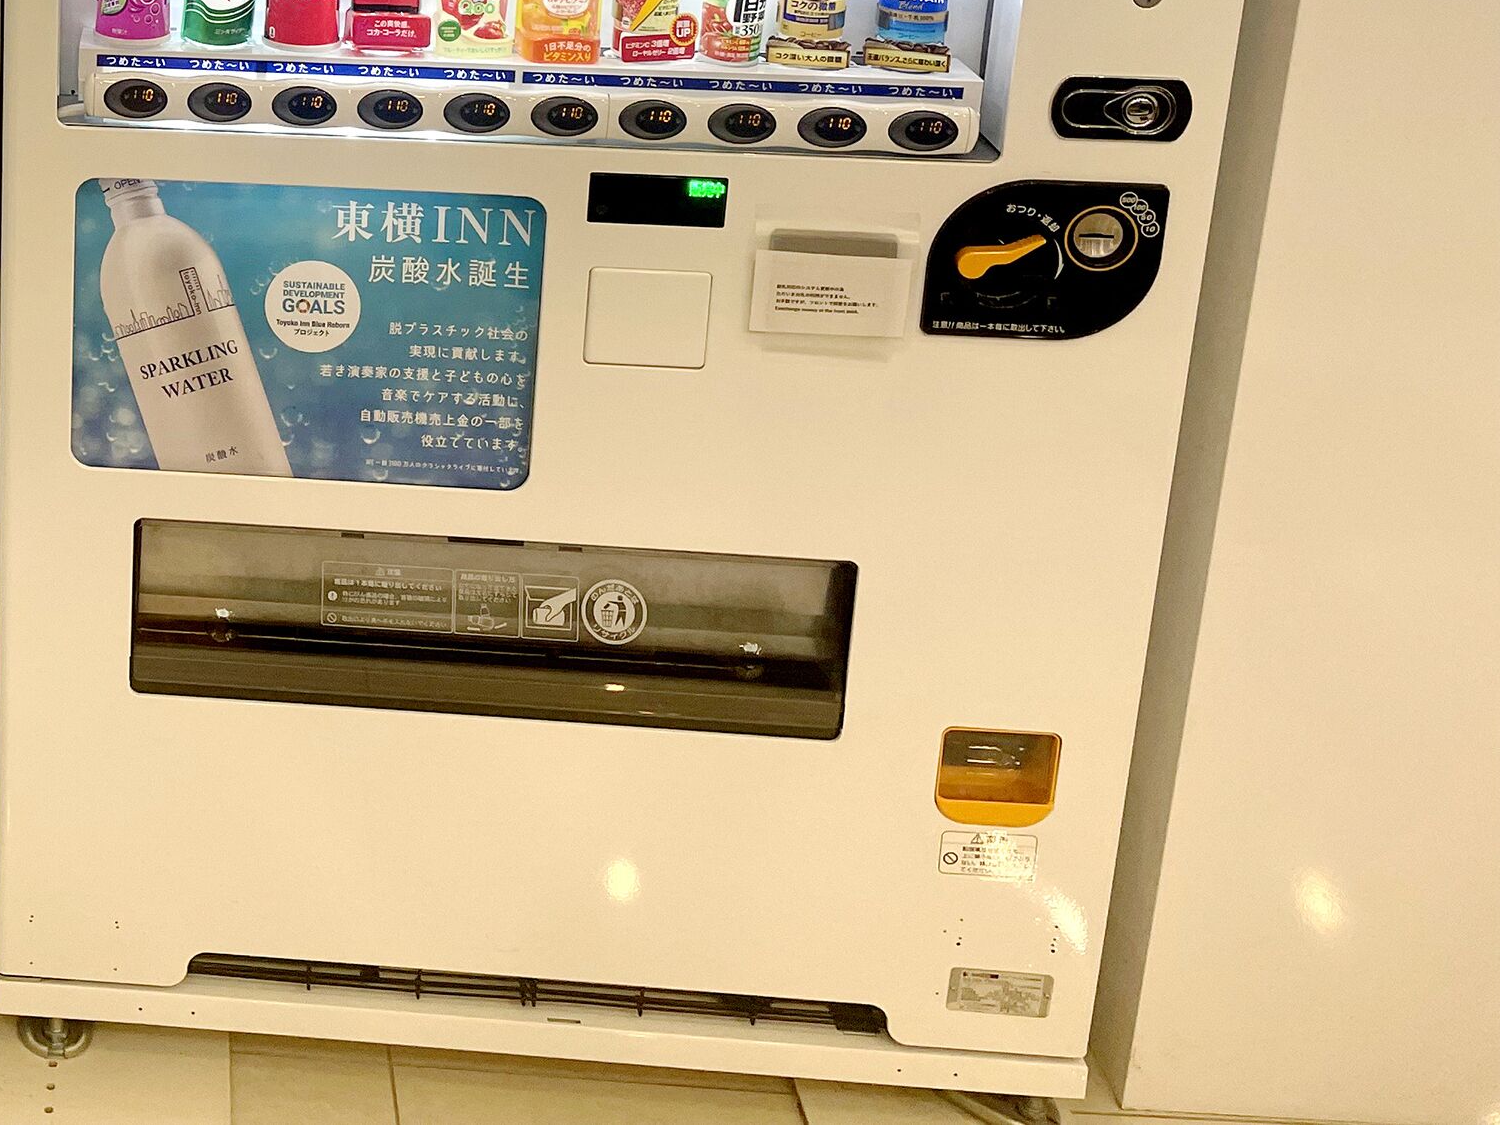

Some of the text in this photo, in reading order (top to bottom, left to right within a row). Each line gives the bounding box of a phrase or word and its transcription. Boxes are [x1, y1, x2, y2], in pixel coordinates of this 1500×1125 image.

[649, 109, 671, 123] 110
[827, 115, 851, 130] 110
[331, 200, 537, 248] 東横INN
[368, 255, 530, 291] 炭酸水誕生
[283, 281, 346, 291] SUSTAINABLE
[283, 289, 345, 300] DEVELOPMENT
[282, 297, 346, 316] GOALS
[293, 329, 330, 338] プロジェクト
[389, 322, 528, 341] 脱プラスチック社会の
[139, 339, 239, 382] SPARKLING
[161, 368, 233, 400] WATER
[319, 364, 526, 390] 若き演奏家の支援と子どもの心を
[360, 409, 524, 430] 自動販売機売上金の一部を
[204, 445, 239, 464] 炭酸水
